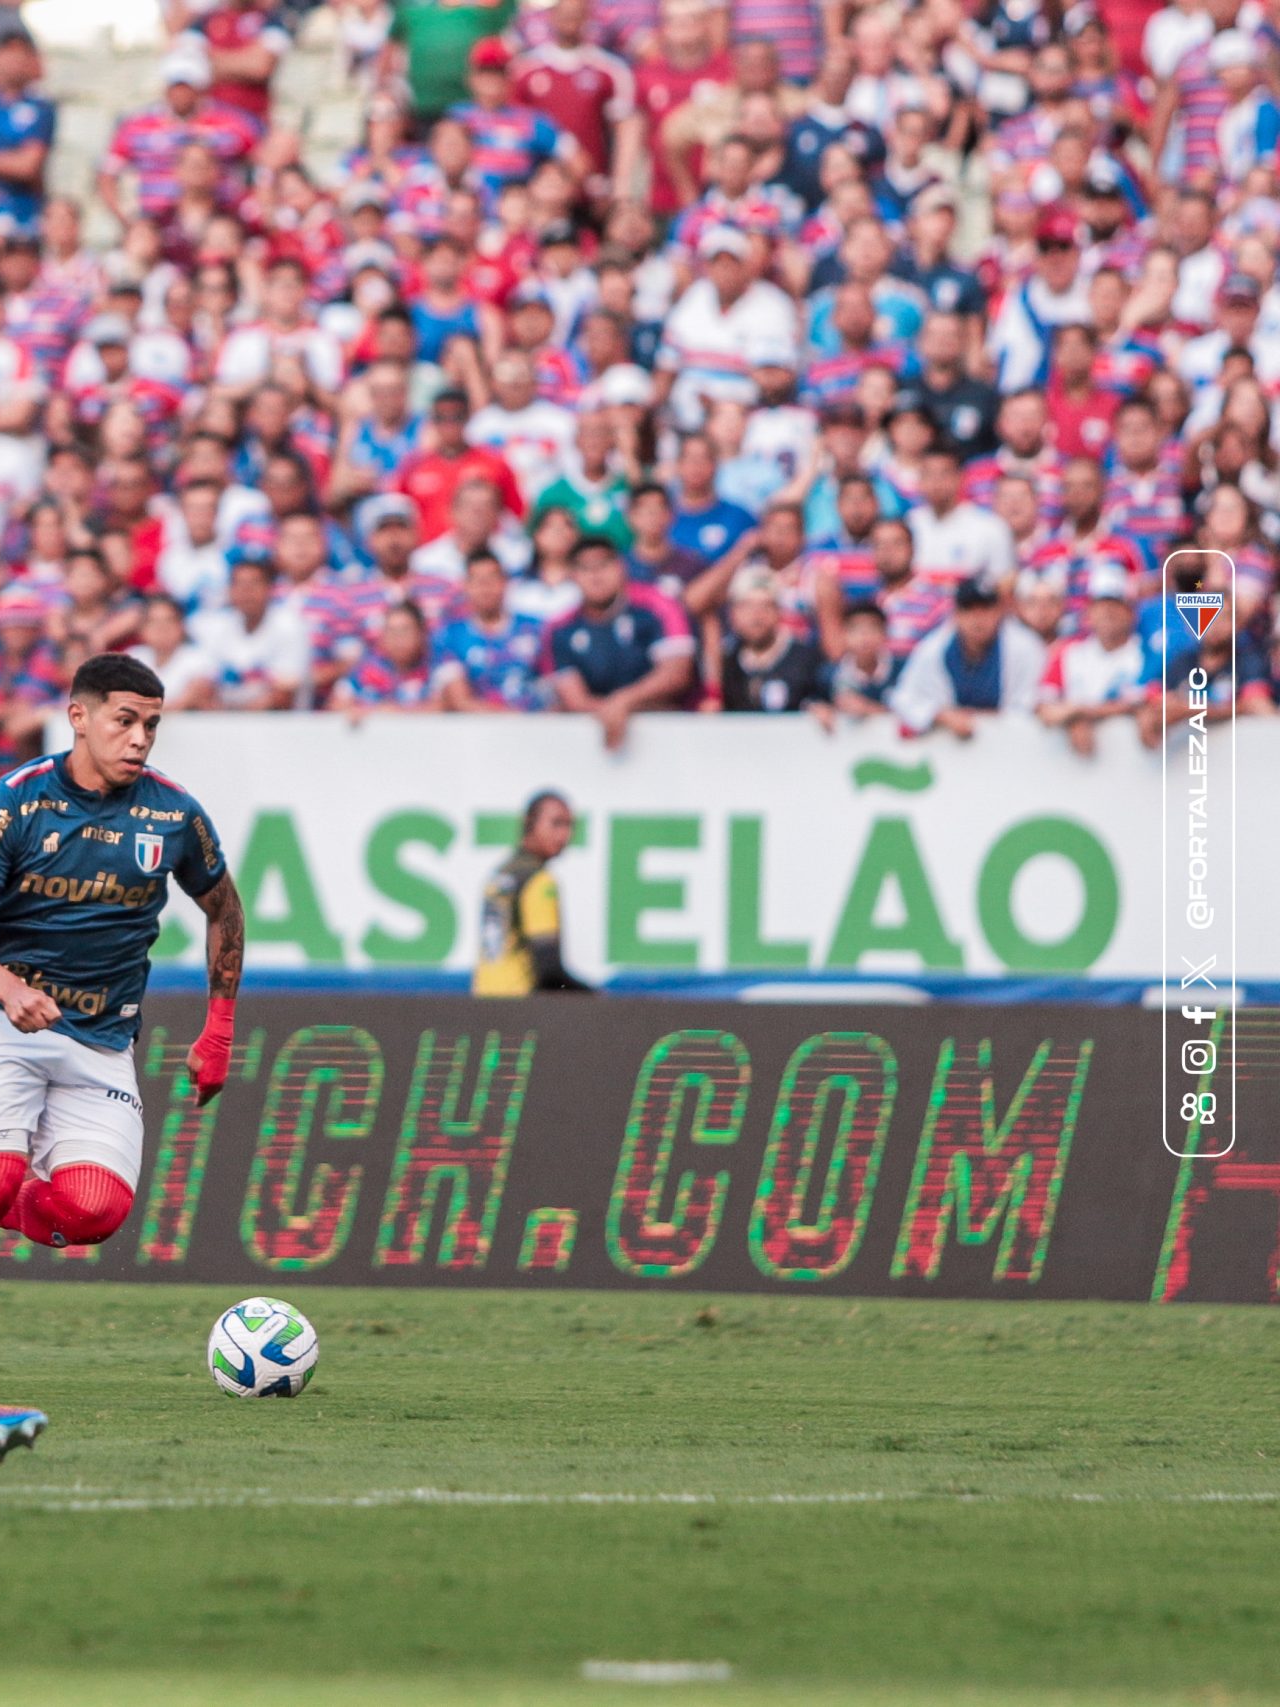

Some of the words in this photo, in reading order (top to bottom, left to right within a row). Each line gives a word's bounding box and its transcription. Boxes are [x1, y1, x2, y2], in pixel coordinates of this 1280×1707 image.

[81, 825, 124, 845] inter
[150, 756, 1120, 974] ASELÃO
[20, 871, 157, 907] novibet
